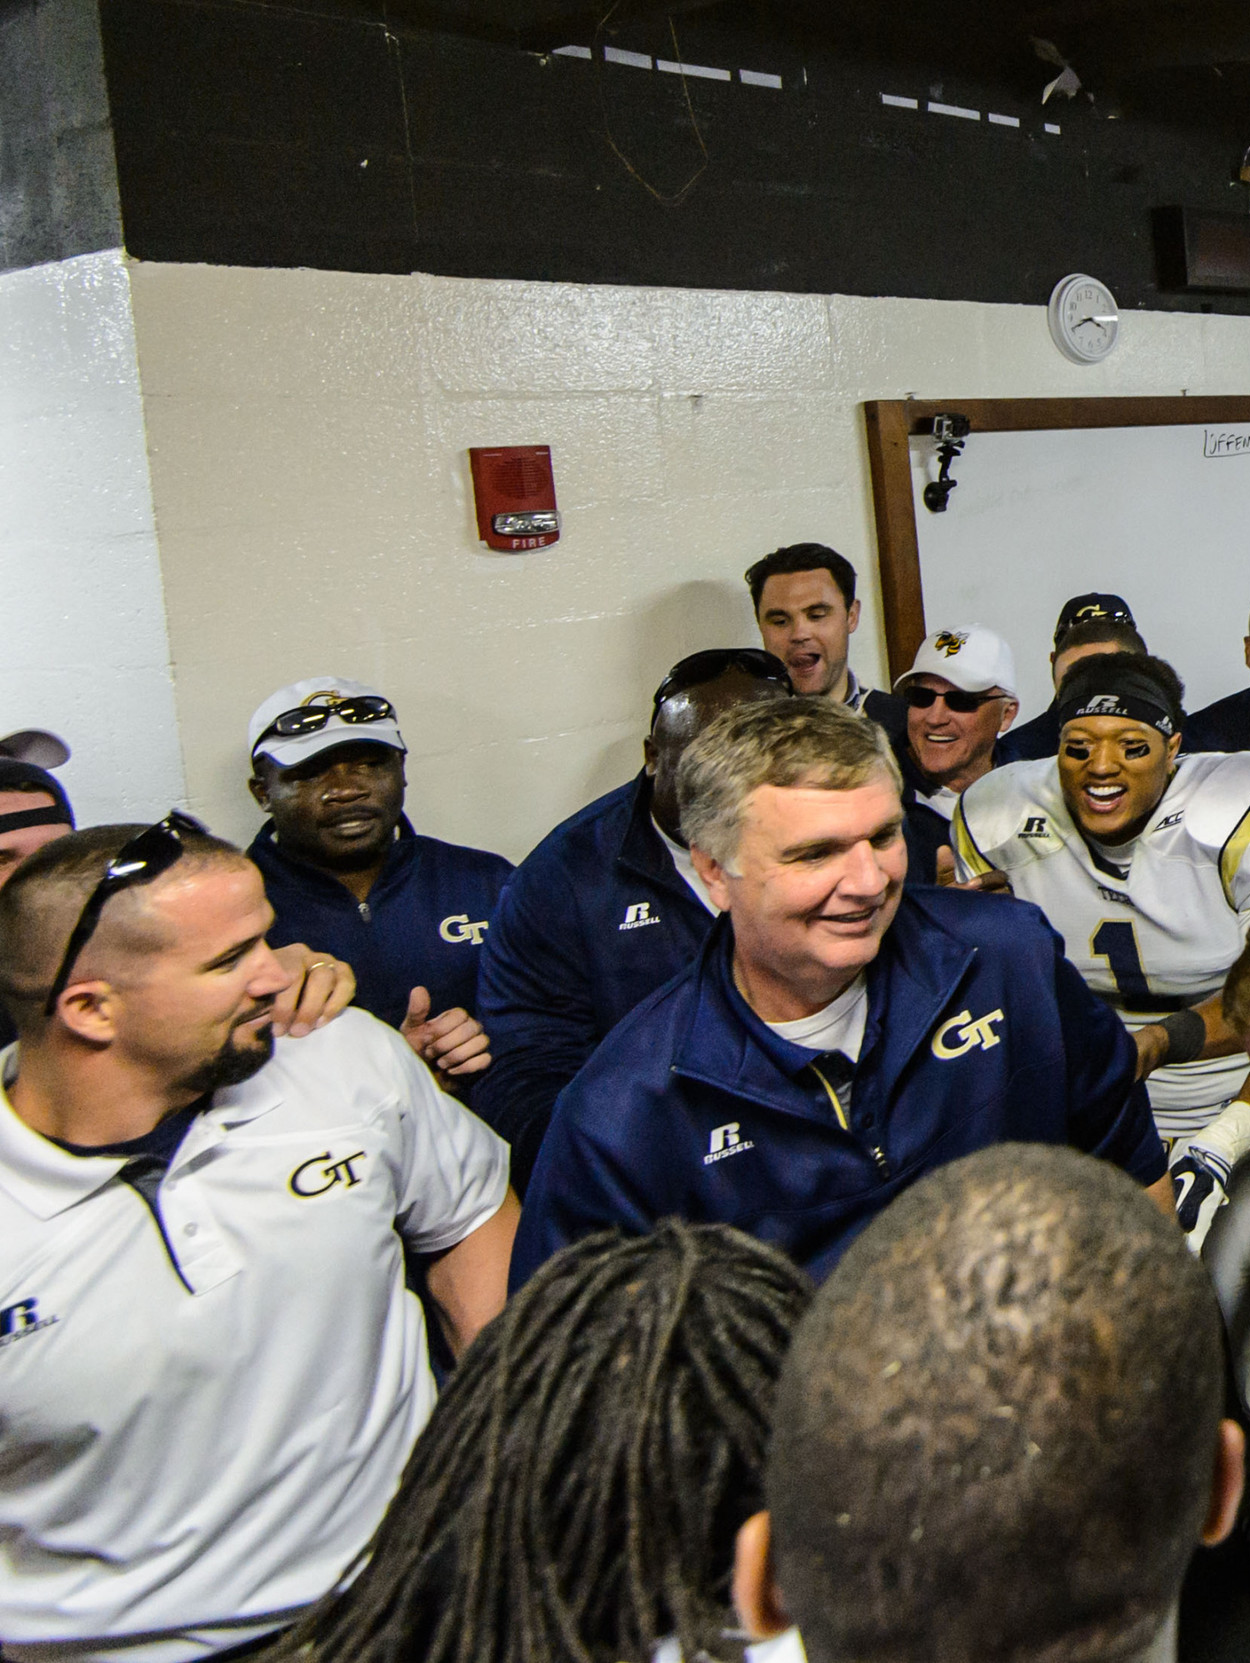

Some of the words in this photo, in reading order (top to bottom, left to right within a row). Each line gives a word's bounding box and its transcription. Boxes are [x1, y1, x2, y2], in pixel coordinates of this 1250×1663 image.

[512, 536, 547, 549] FIRE
[1076, 706, 1128, 715] RUSSELL
[1152, 809, 1185, 833] ACC
[439, 913, 490, 946] GT
[618, 916, 661, 931] RUSSELL
[1088, 917, 1152, 996] 1
[931, 1008, 1005, 1061] GT
[703, 1140, 755, 1166] RUSSELL
[286, 1150, 368, 1200] GT
